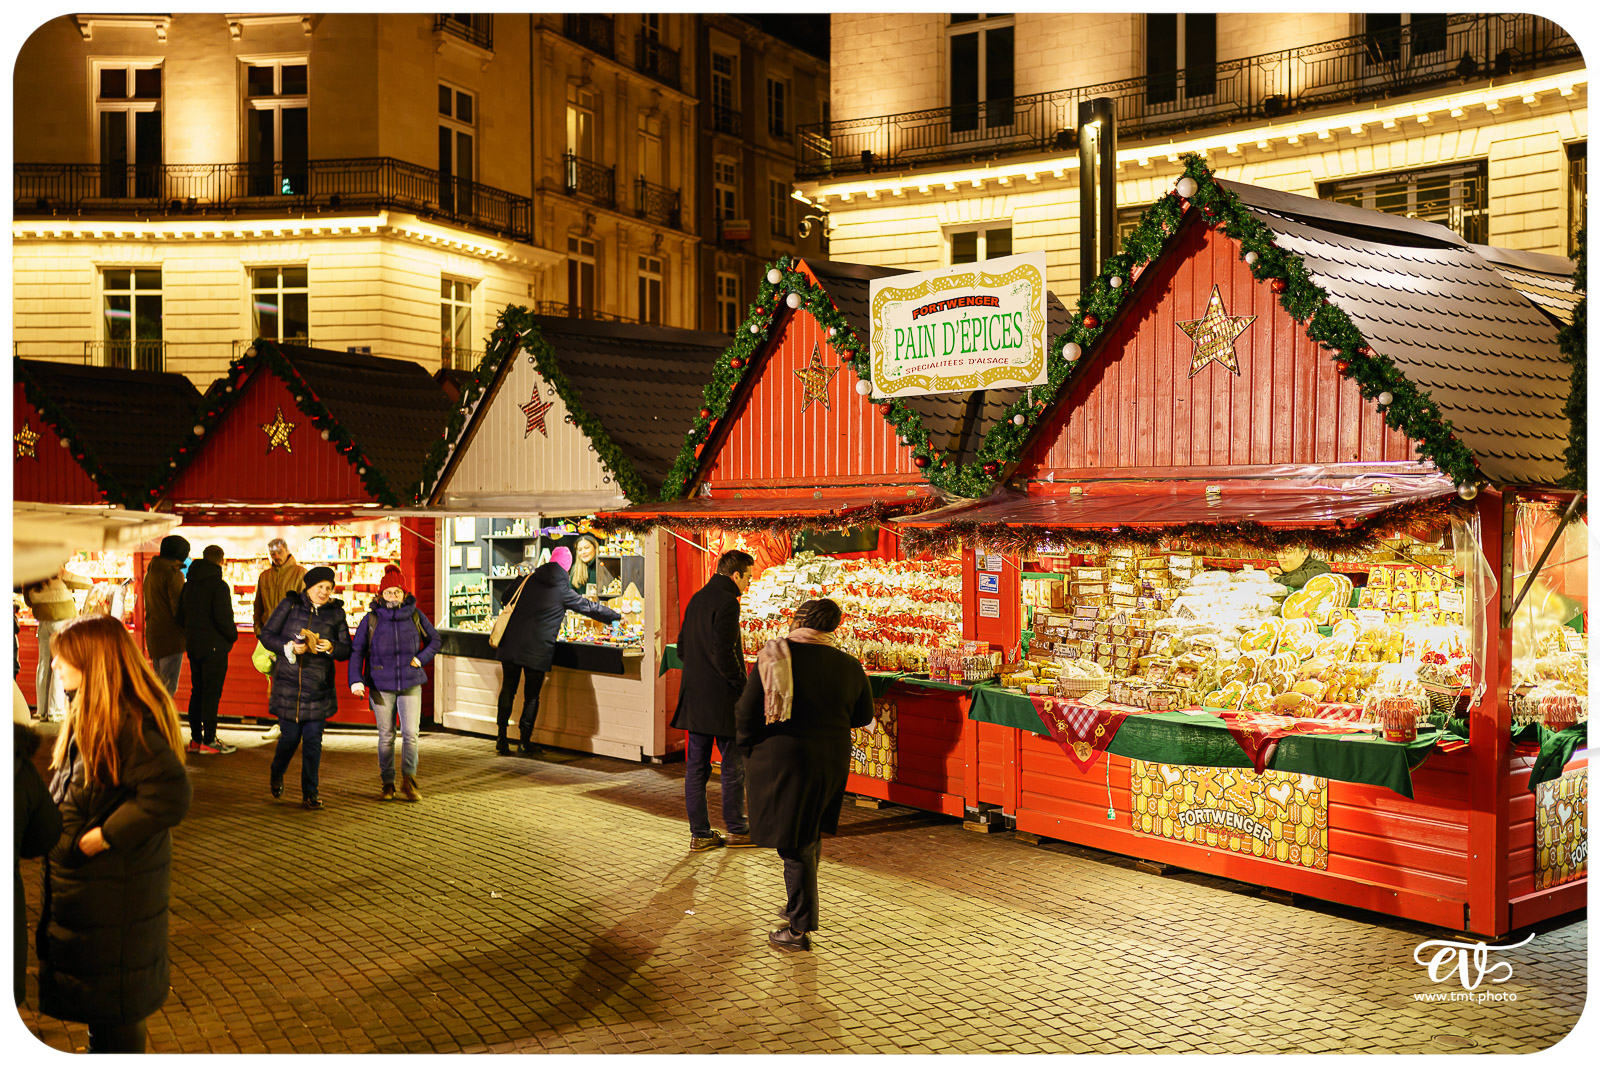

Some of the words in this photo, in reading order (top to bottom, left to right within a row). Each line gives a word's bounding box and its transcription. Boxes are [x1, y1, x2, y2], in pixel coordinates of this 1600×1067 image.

[912, 296, 999, 320] FORTWENGER
[894, 323, 937, 361] PAIN
[942, 312, 1024, 356] D'ÉPICES
[968, 357, 1009, 365] D'ALSACE
[1178, 808, 1273, 846] FORTWENGER
